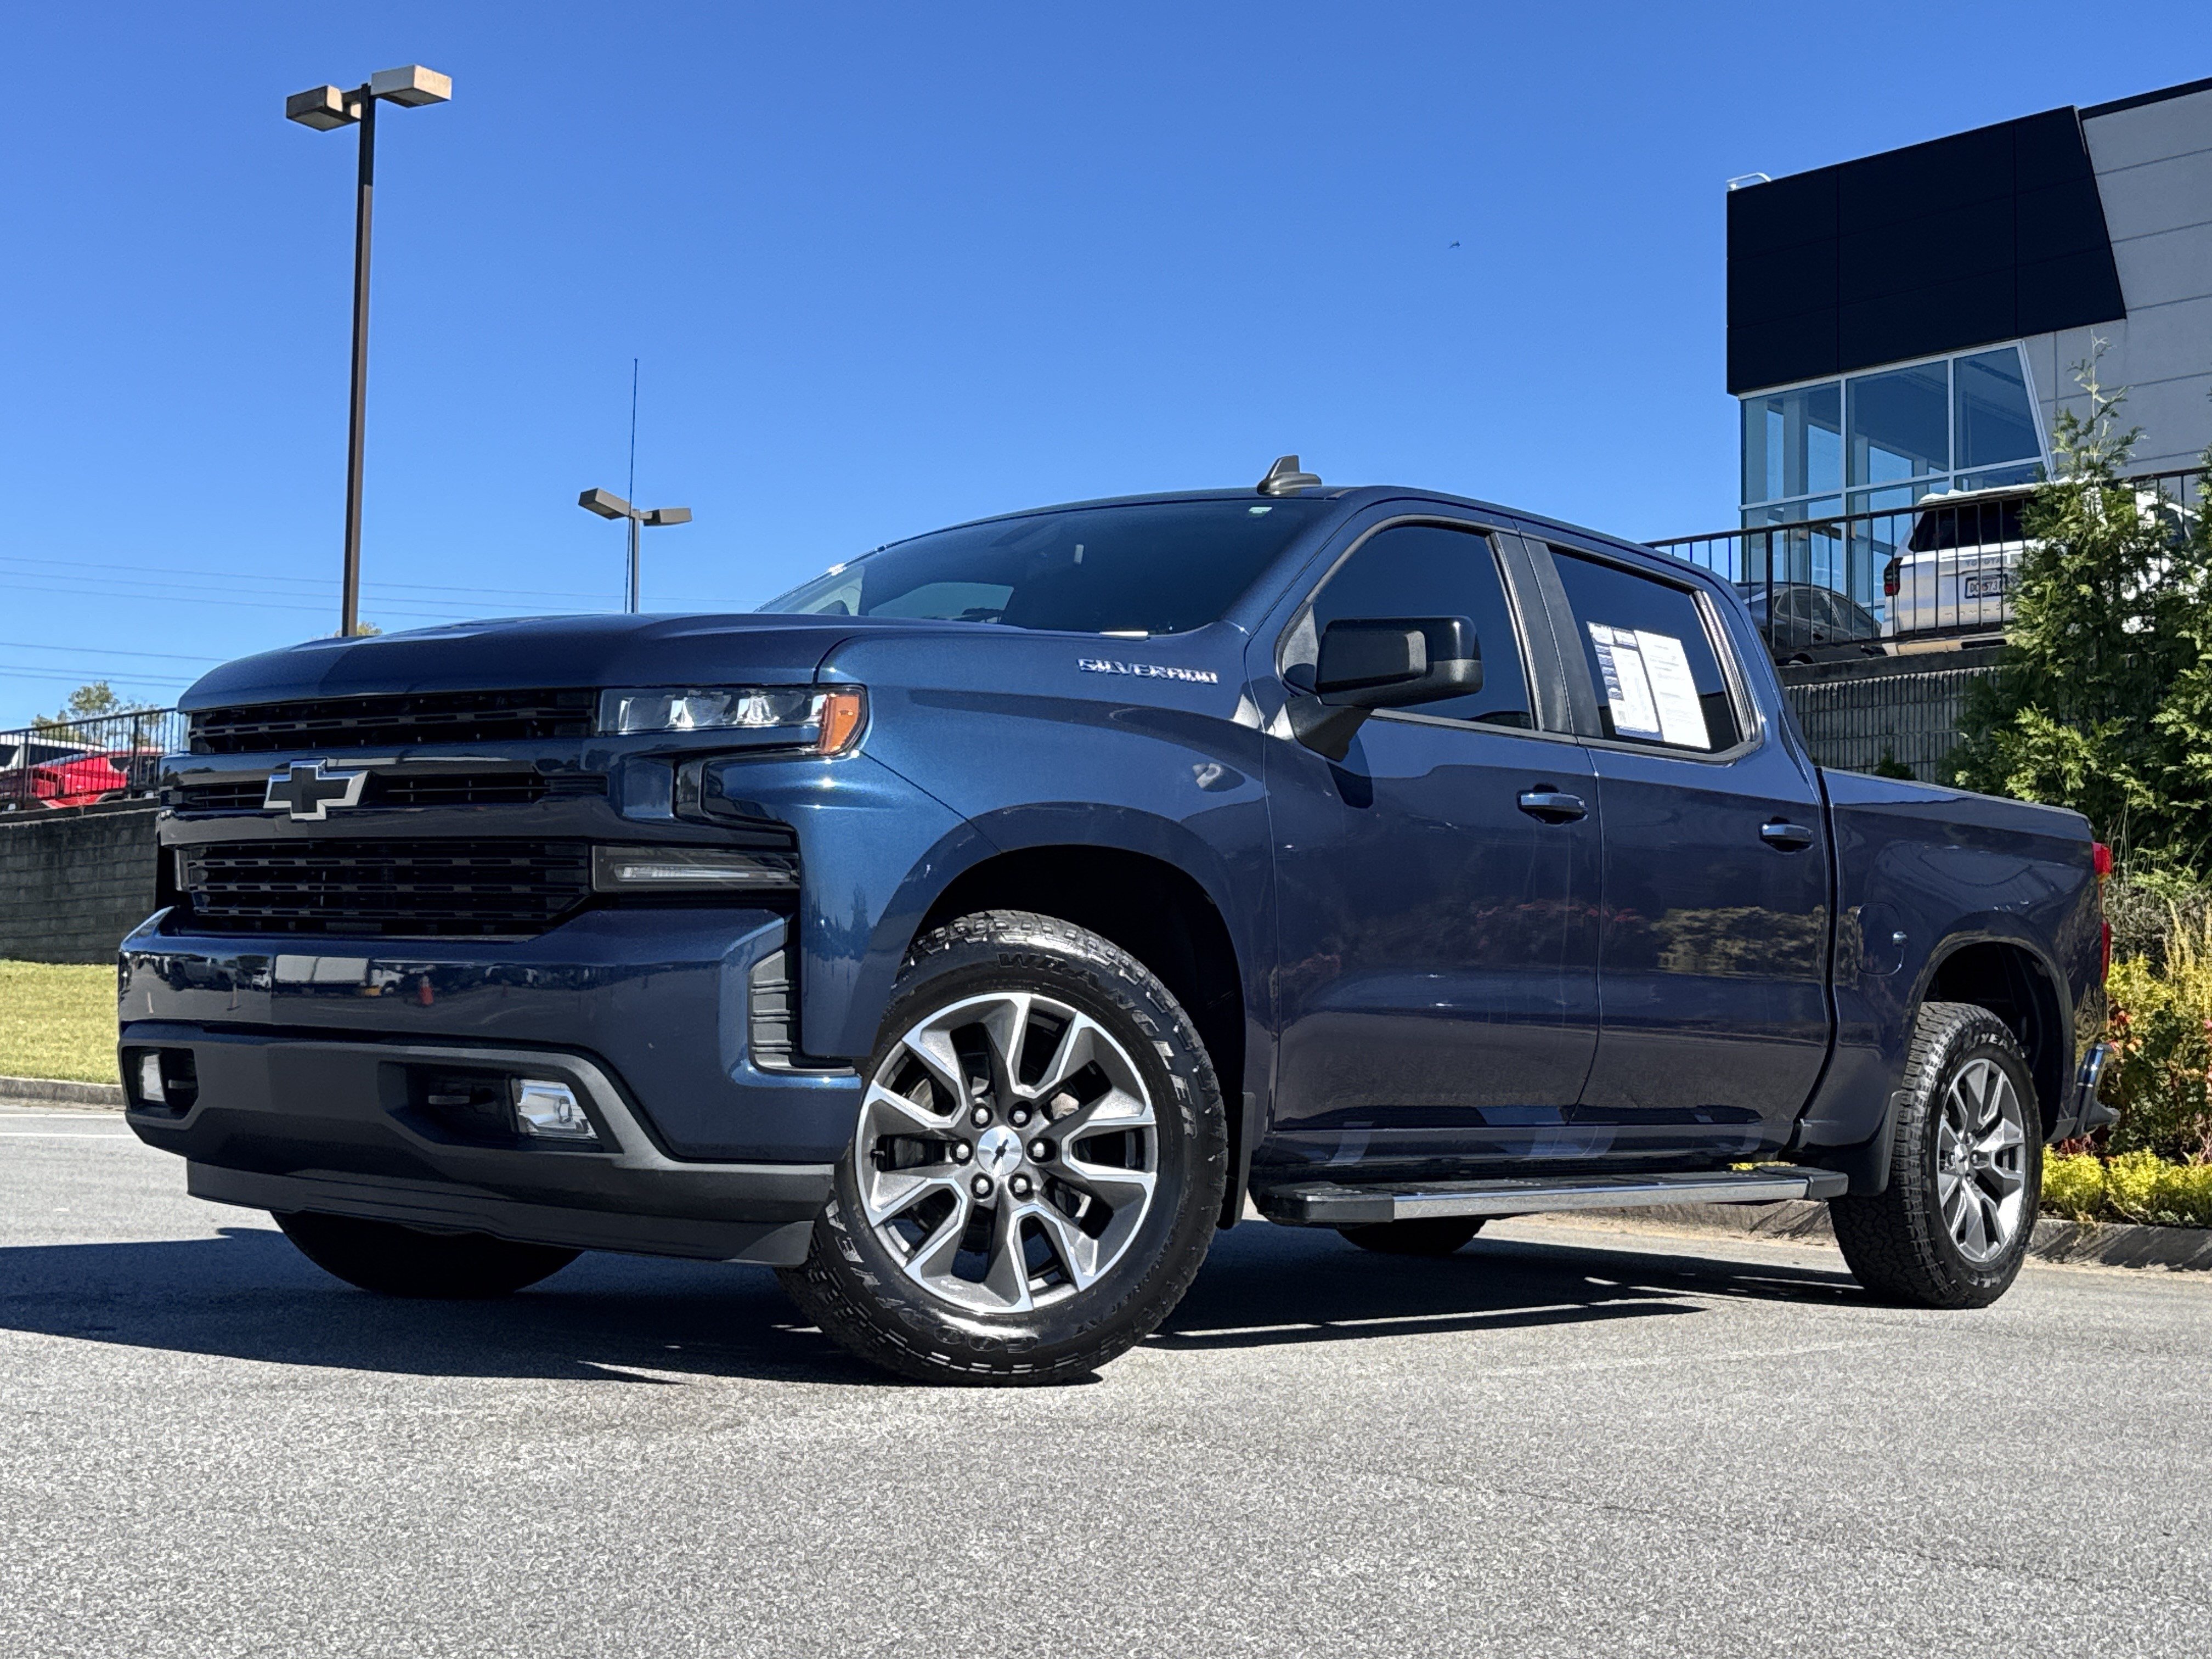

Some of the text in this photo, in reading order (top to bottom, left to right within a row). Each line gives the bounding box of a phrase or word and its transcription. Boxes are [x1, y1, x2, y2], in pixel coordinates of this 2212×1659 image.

[1078, 659, 1218, 684] SILVERADO
[997, 952, 1197, 1139] WRANGLER
[826, 1200, 1039, 1353] GOODYEA
